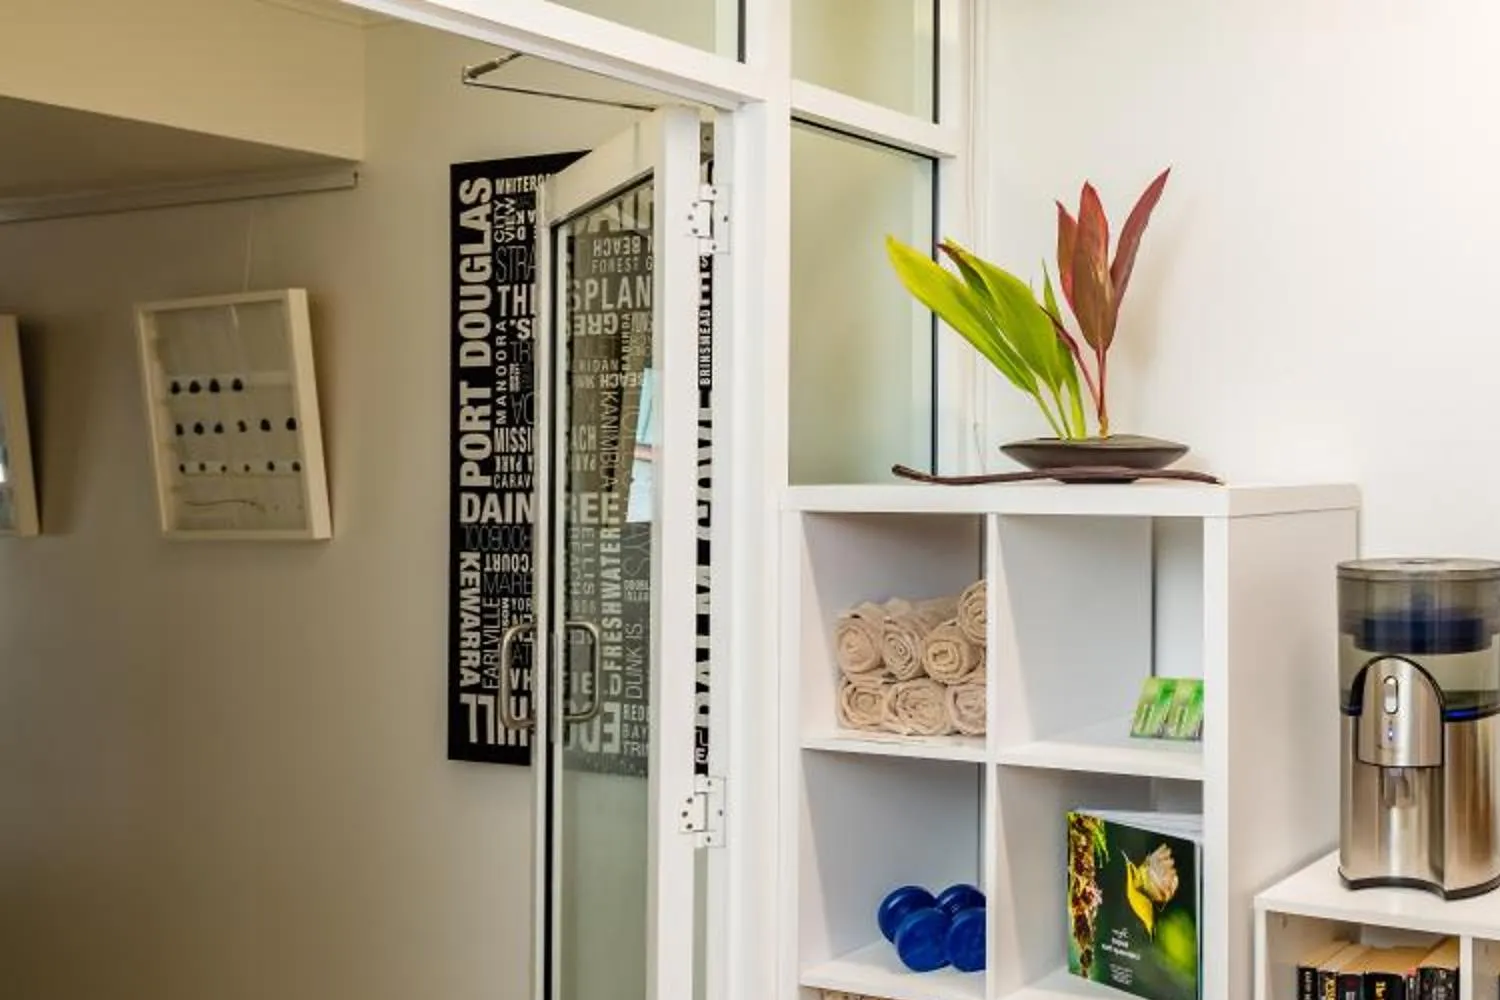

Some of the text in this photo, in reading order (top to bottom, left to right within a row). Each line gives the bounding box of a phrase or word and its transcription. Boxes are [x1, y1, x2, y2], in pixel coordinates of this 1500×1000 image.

[459, 177, 493, 487] PORT DOUGLAS
[495, 320, 507, 425] MANOORA
[459, 551, 481, 687] KEWARRA
[600, 527, 622, 671] FRESHWATER
